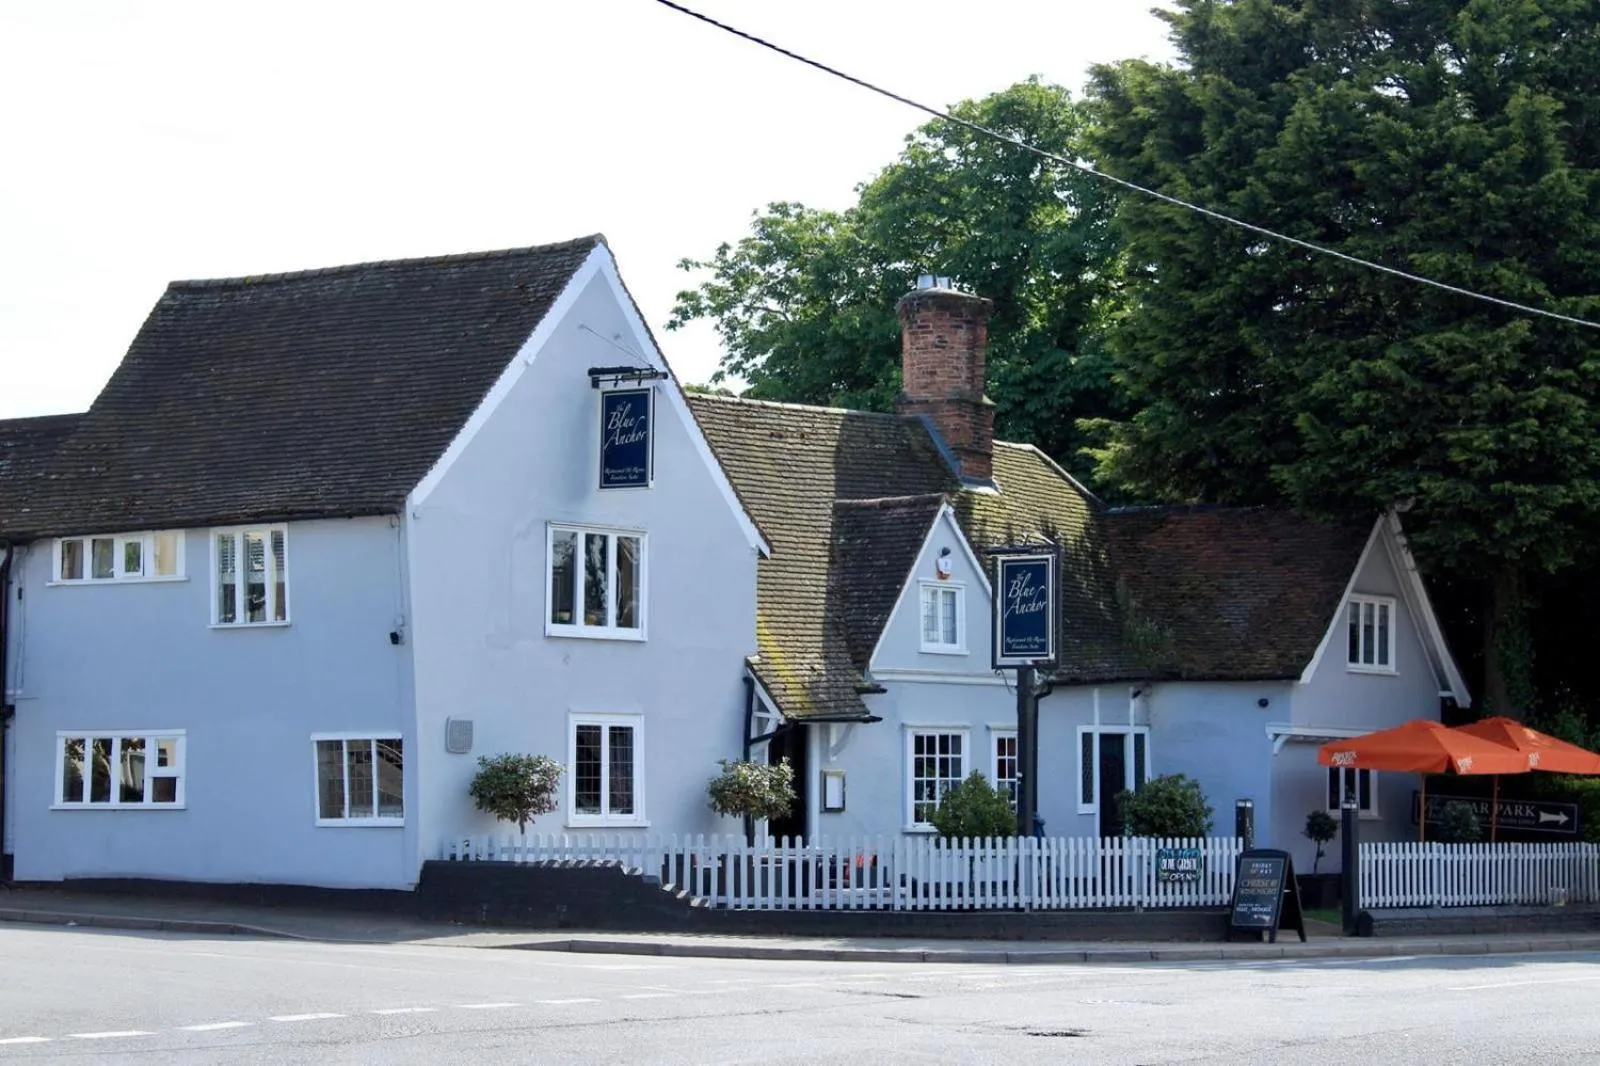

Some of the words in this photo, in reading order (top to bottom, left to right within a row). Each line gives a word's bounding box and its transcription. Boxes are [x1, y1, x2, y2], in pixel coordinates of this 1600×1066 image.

[608, 403, 635, 430] Blue
[604, 415, 647, 450] Anchor
[1008, 572, 1036, 598] Blue
[1005, 585, 1047, 618] Anchor
[1470, 801, 1489, 814] AR
[1496, 803, 1536, 817] PARK
